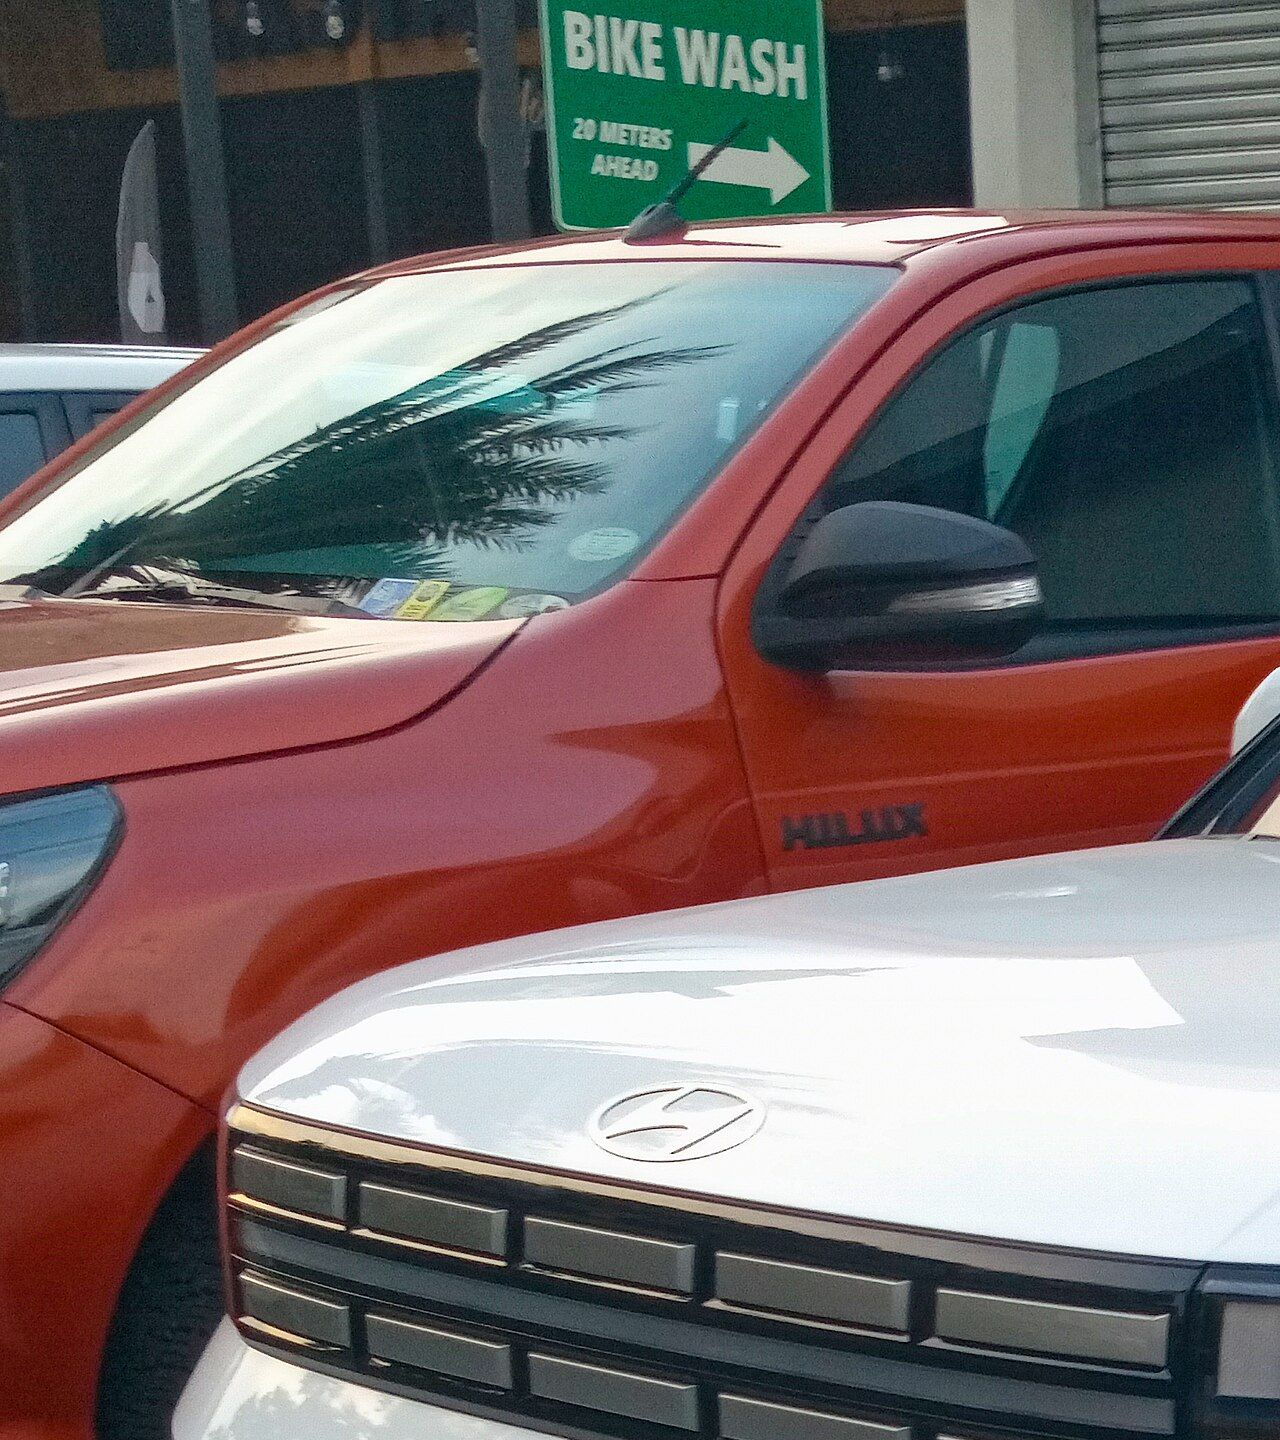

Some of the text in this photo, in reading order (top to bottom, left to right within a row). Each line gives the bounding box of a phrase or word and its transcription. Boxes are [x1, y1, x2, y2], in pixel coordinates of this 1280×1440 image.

[563, 10, 808, 100] BIKE WASH
[572, 117, 673, 151] 20 METERS
[591, 153, 659, 182] AHEAD
[781, 802, 928, 851] HILUX
